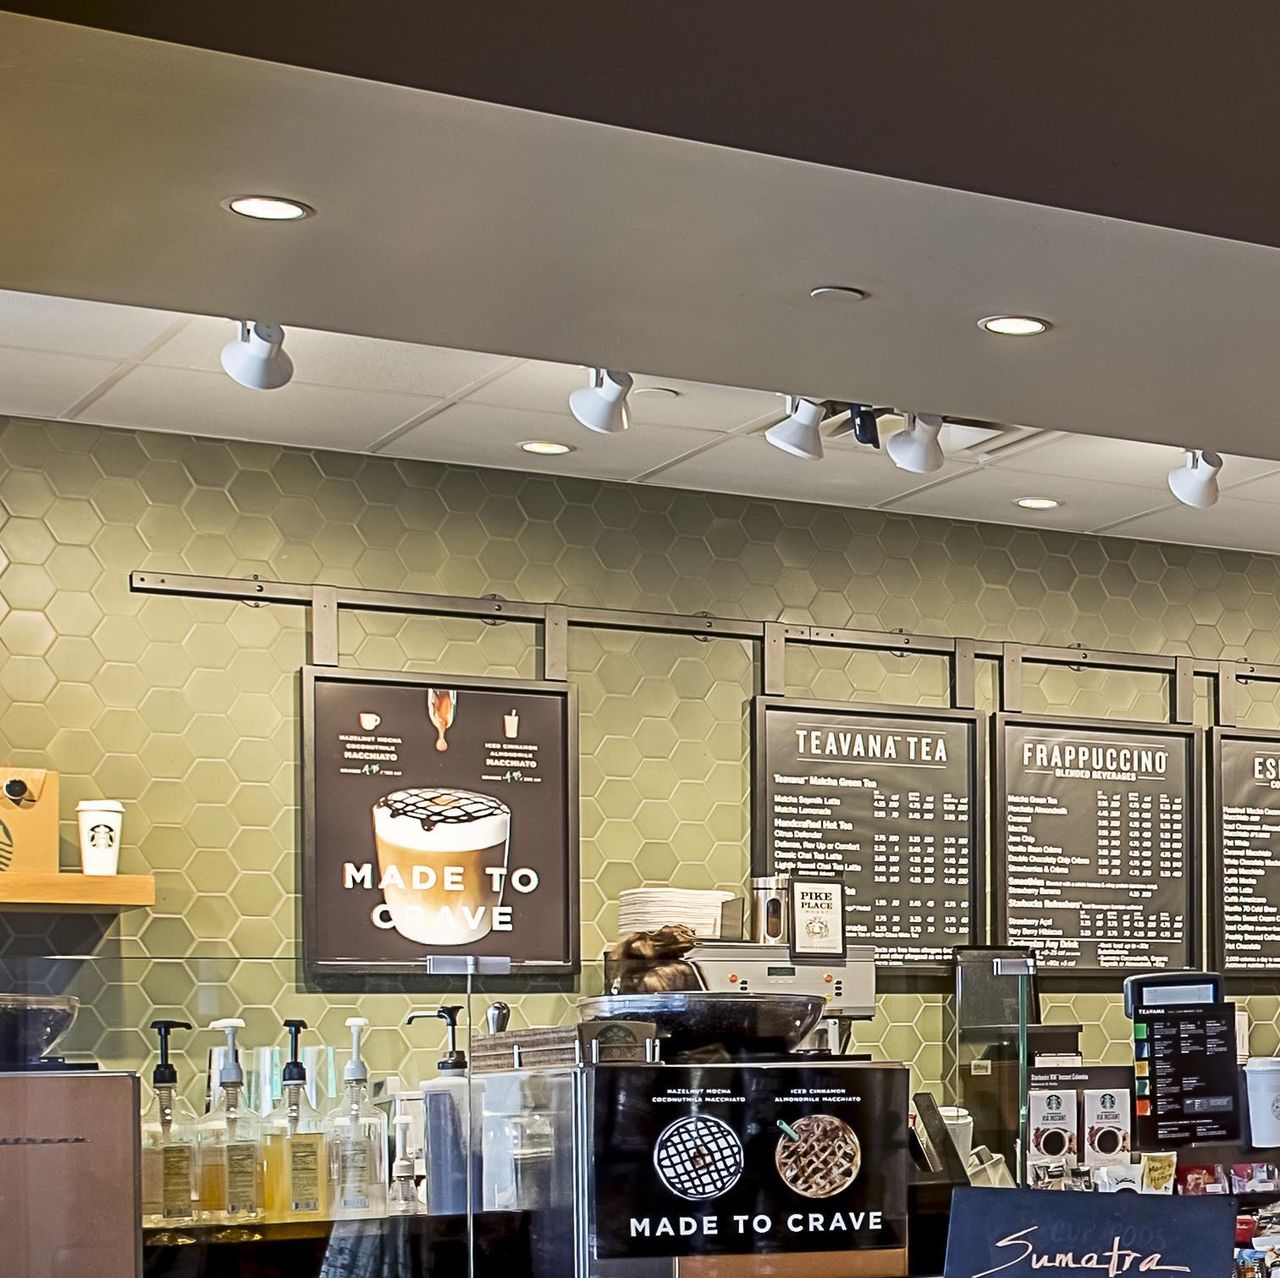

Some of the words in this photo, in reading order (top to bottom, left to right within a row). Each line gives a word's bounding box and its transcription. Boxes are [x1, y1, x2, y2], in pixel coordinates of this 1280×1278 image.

[344, 751, 397, 762] MACCHIATO
[907, 736, 947, 761] TEA
[1023, 743, 1168, 773] FRAPPUCCINO
[486, 758, 537, 769] MACCHIATO
[1055, 768, 1091, 779] BLENDED
[1092, 770, 1137, 781] BEVERAGES
[344, 863, 464, 891] MADE
[485, 867, 539, 894] TO
[800, 891, 833, 901] PIKE
[801, 902, 833, 910] PLACE
[372, 903, 513, 932] CRAVE
[630, 1215, 719, 1238] MADE
[733, 1214, 772, 1234] TO
[787, 1211, 883, 1233] CRAVE
[971, 1225, 1190, 1278] Sumatra
